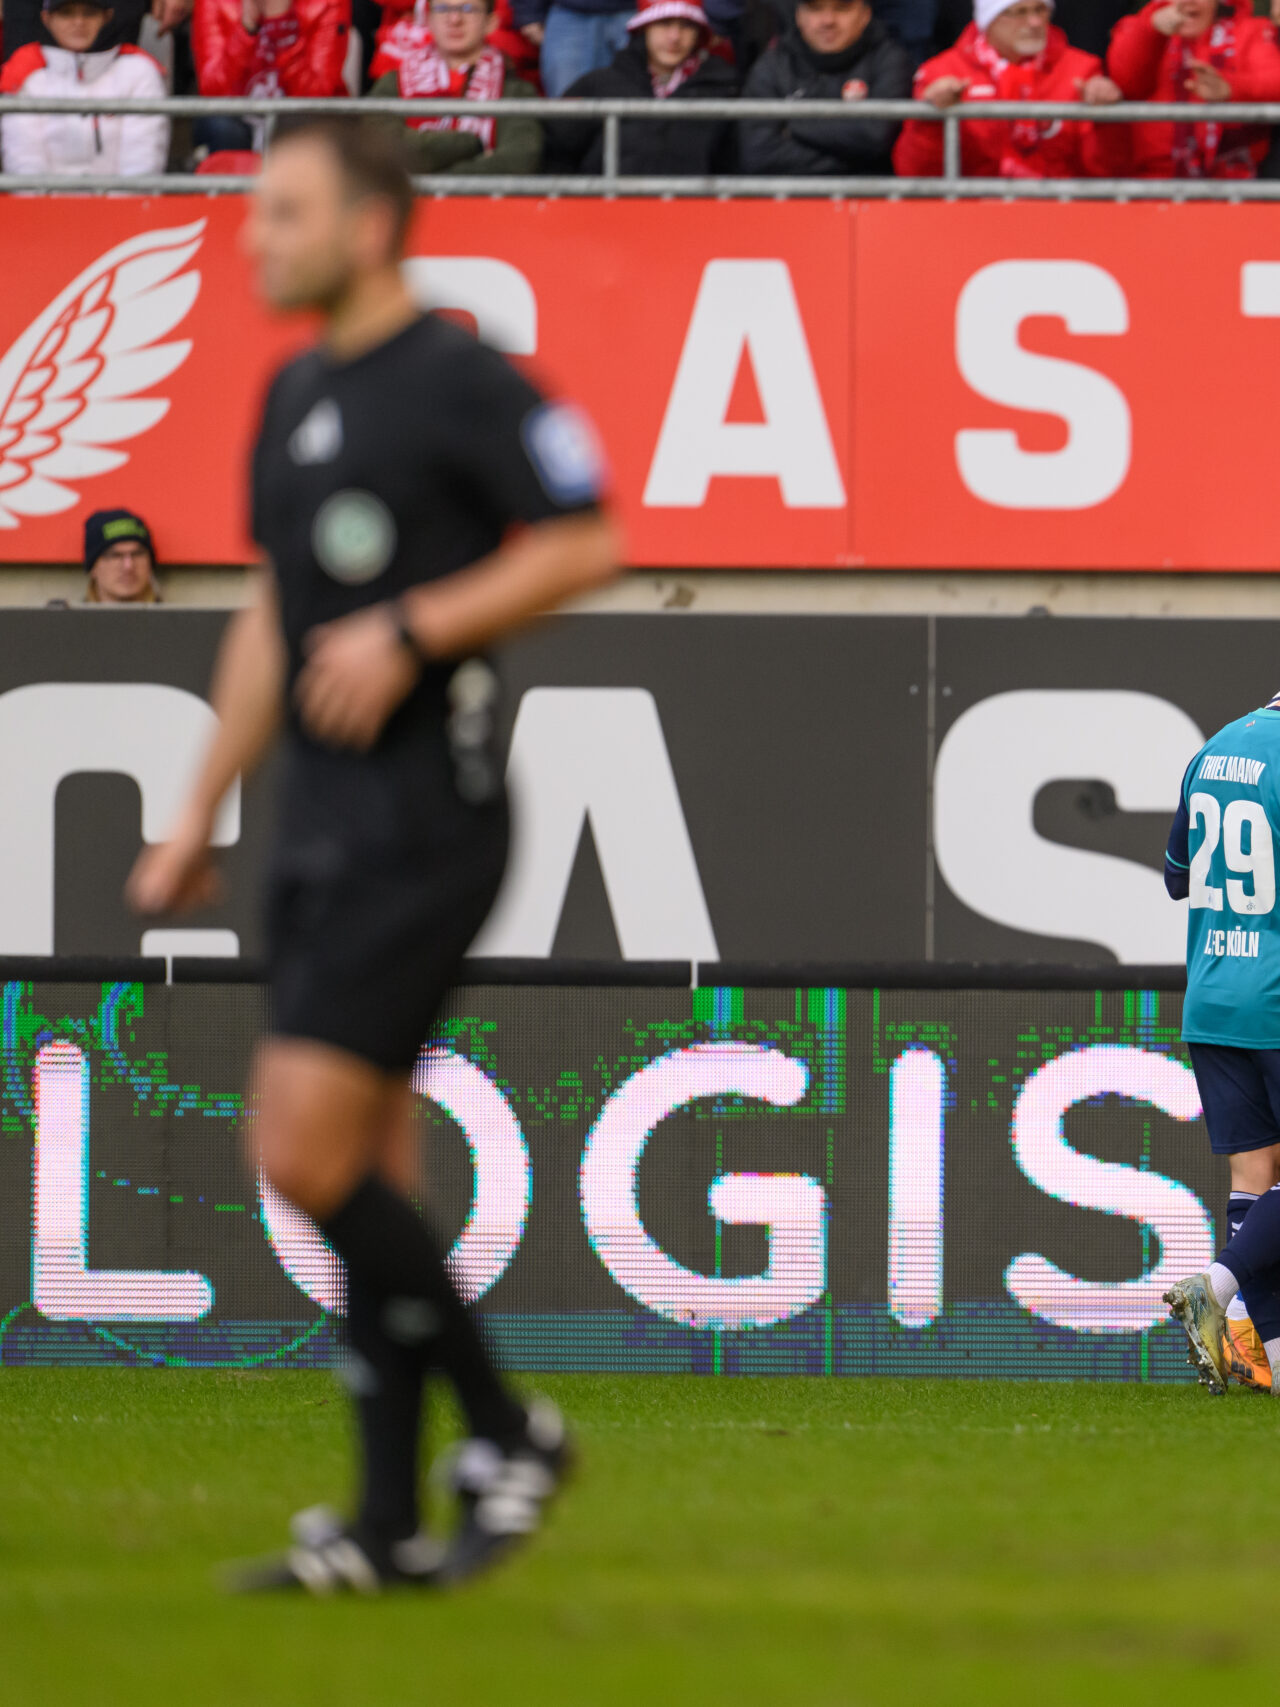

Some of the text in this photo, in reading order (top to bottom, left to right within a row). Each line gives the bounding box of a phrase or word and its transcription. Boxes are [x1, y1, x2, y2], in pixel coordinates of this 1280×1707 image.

[1199, 755, 1266, 786] THIELMANN
[1189, 792, 1276, 916] 29
[1226, 925, 1260, 957] KÖLN
